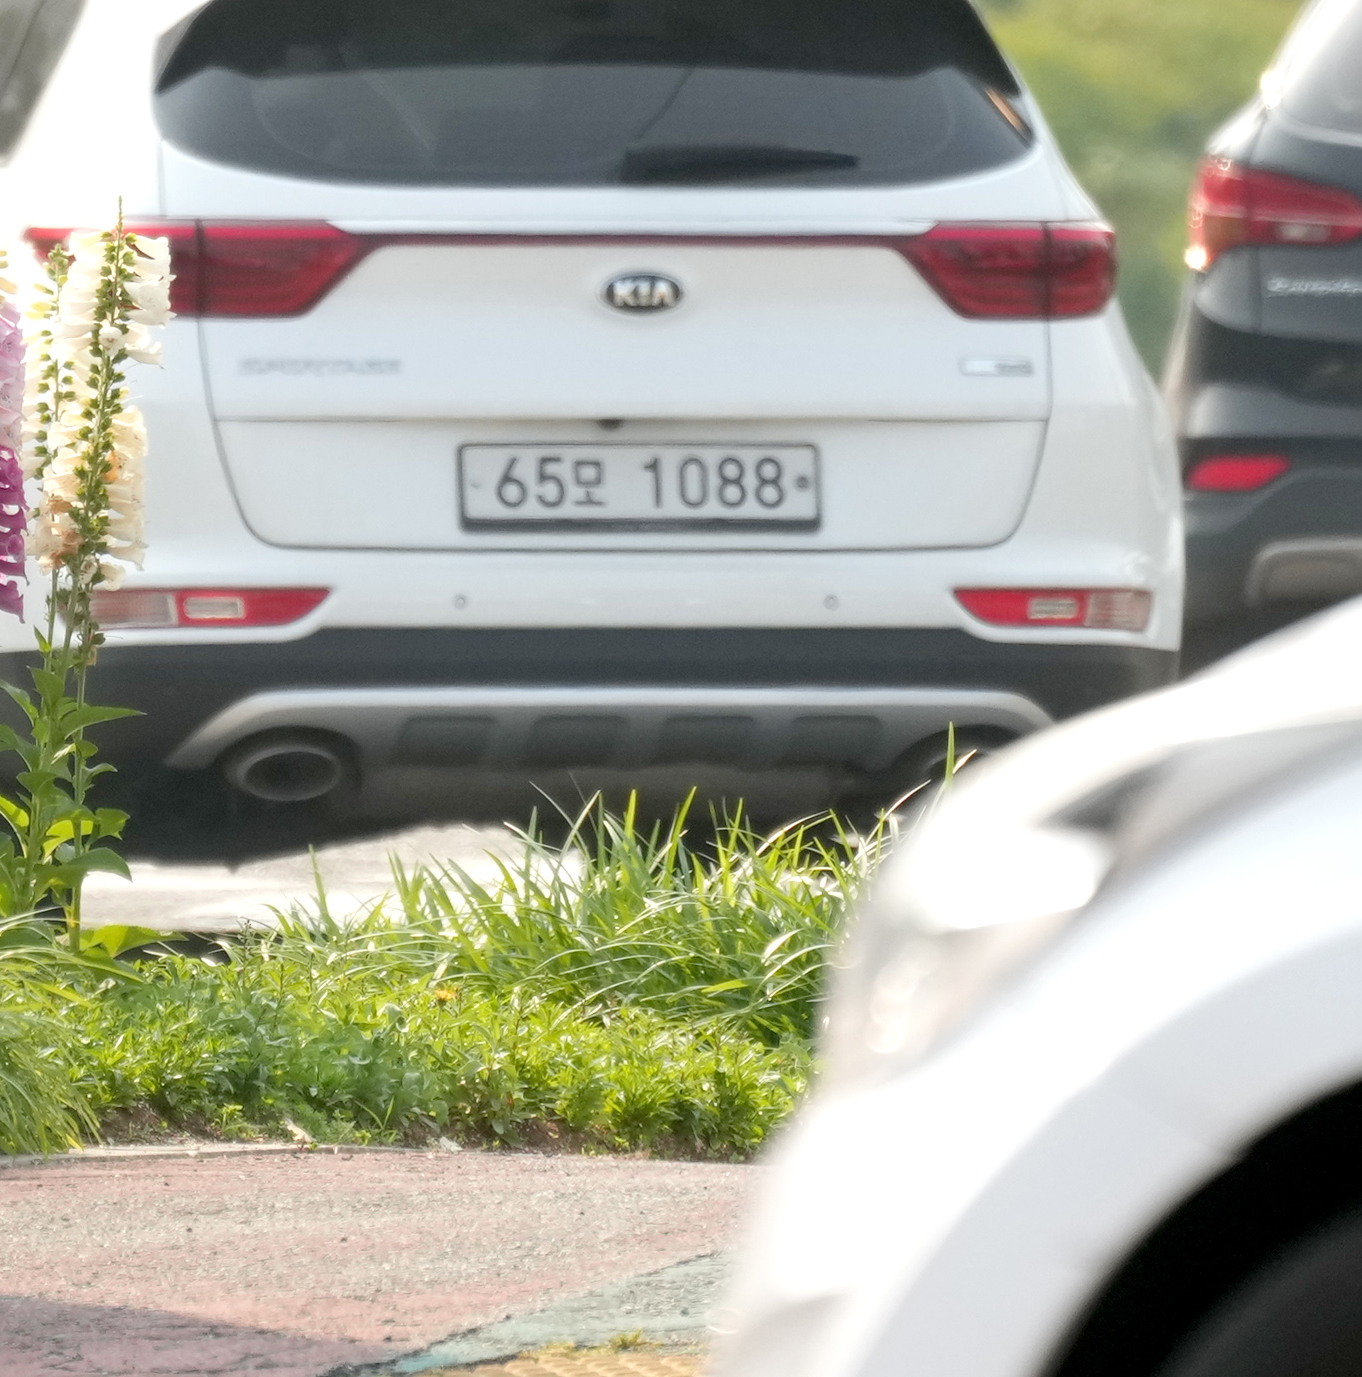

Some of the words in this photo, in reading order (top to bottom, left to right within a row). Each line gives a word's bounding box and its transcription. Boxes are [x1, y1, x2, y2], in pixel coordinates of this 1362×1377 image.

[613, 279, 675, 307] KIA
[496, 456, 605, 508] 65모
[642, 455, 785, 508] 1088
